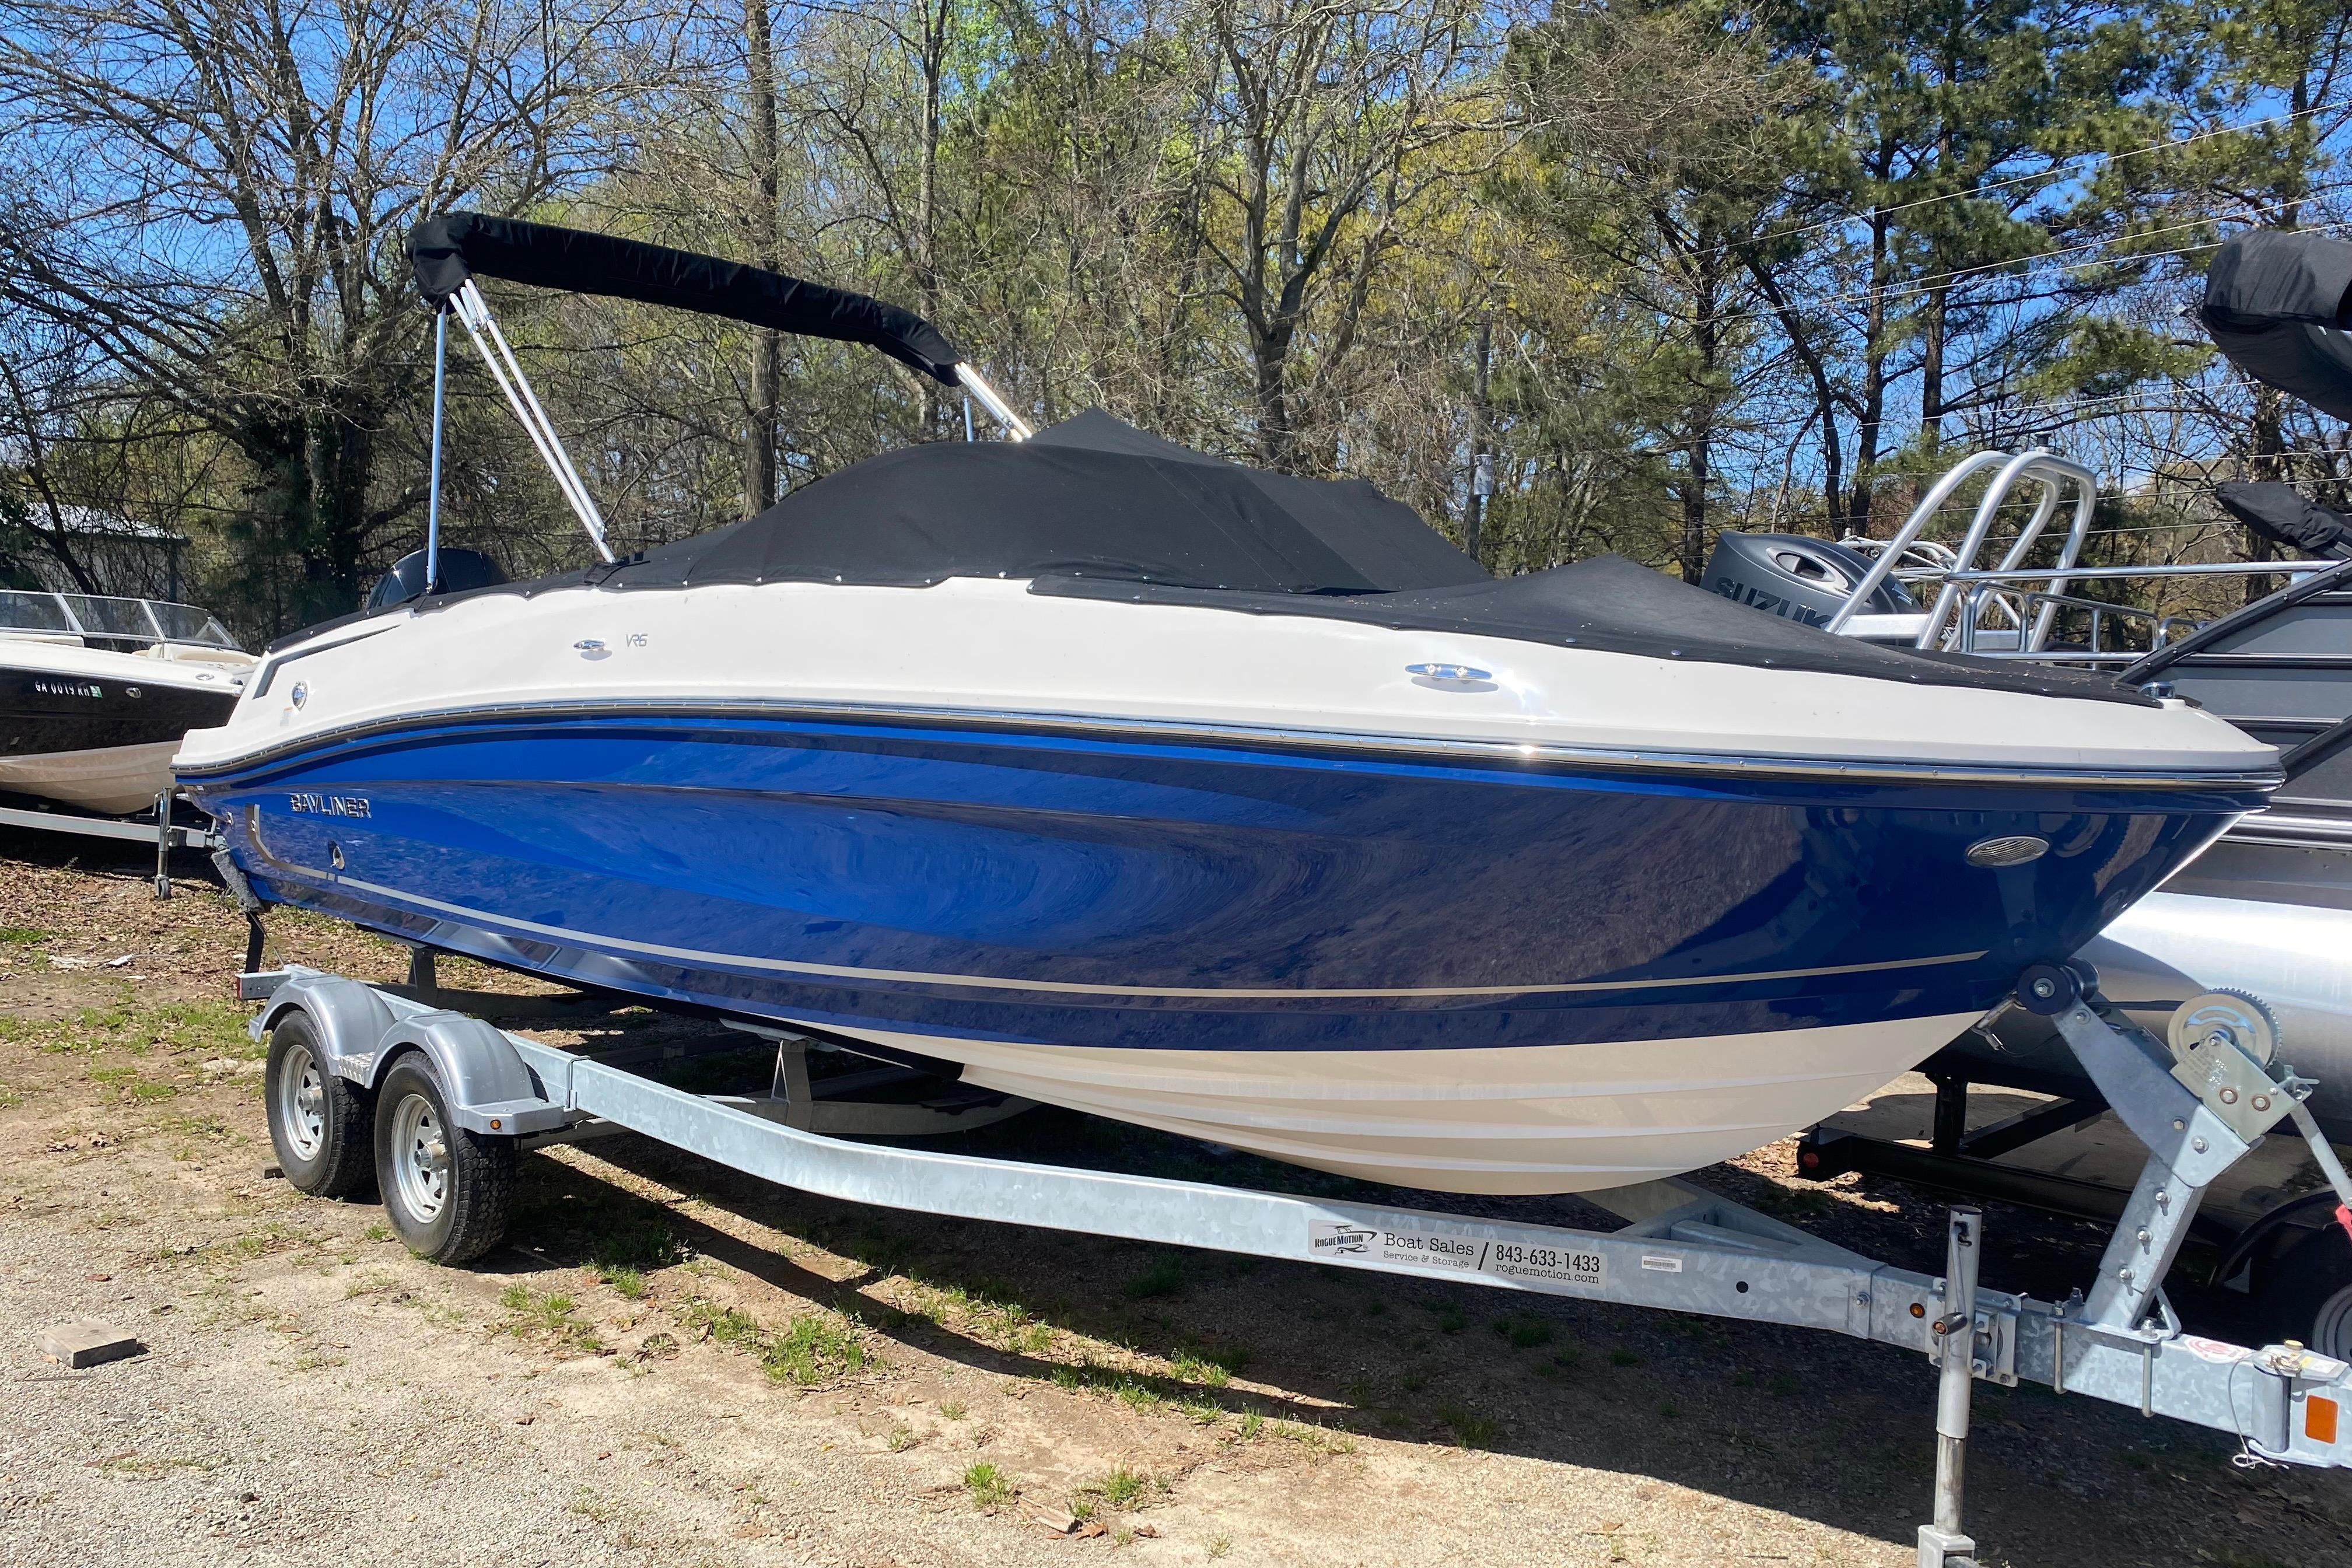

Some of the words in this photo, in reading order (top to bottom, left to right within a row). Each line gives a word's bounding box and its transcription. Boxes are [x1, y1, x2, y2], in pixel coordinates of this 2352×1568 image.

[1713, 576, 1833, 629] SUZUK
[625, 633, 648, 647] VR6
[35, 681, 47, 693] GA
[51, 682, 74, 695] 0019
[290, 793, 372, 818] BAYLINER
[1384, 1232, 1424, 1250] Boat
[1430, 1238, 1474, 1255] Sales
[1383, 1251, 1418, 1262] Service
[1421, 1255, 1430, 1263] &
[1432, 1256, 1469, 1269] Storage
[1496, 1244, 1600, 1272] 843-633-1433
[1495, 1264, 1600, 1283] roguemotion.com
